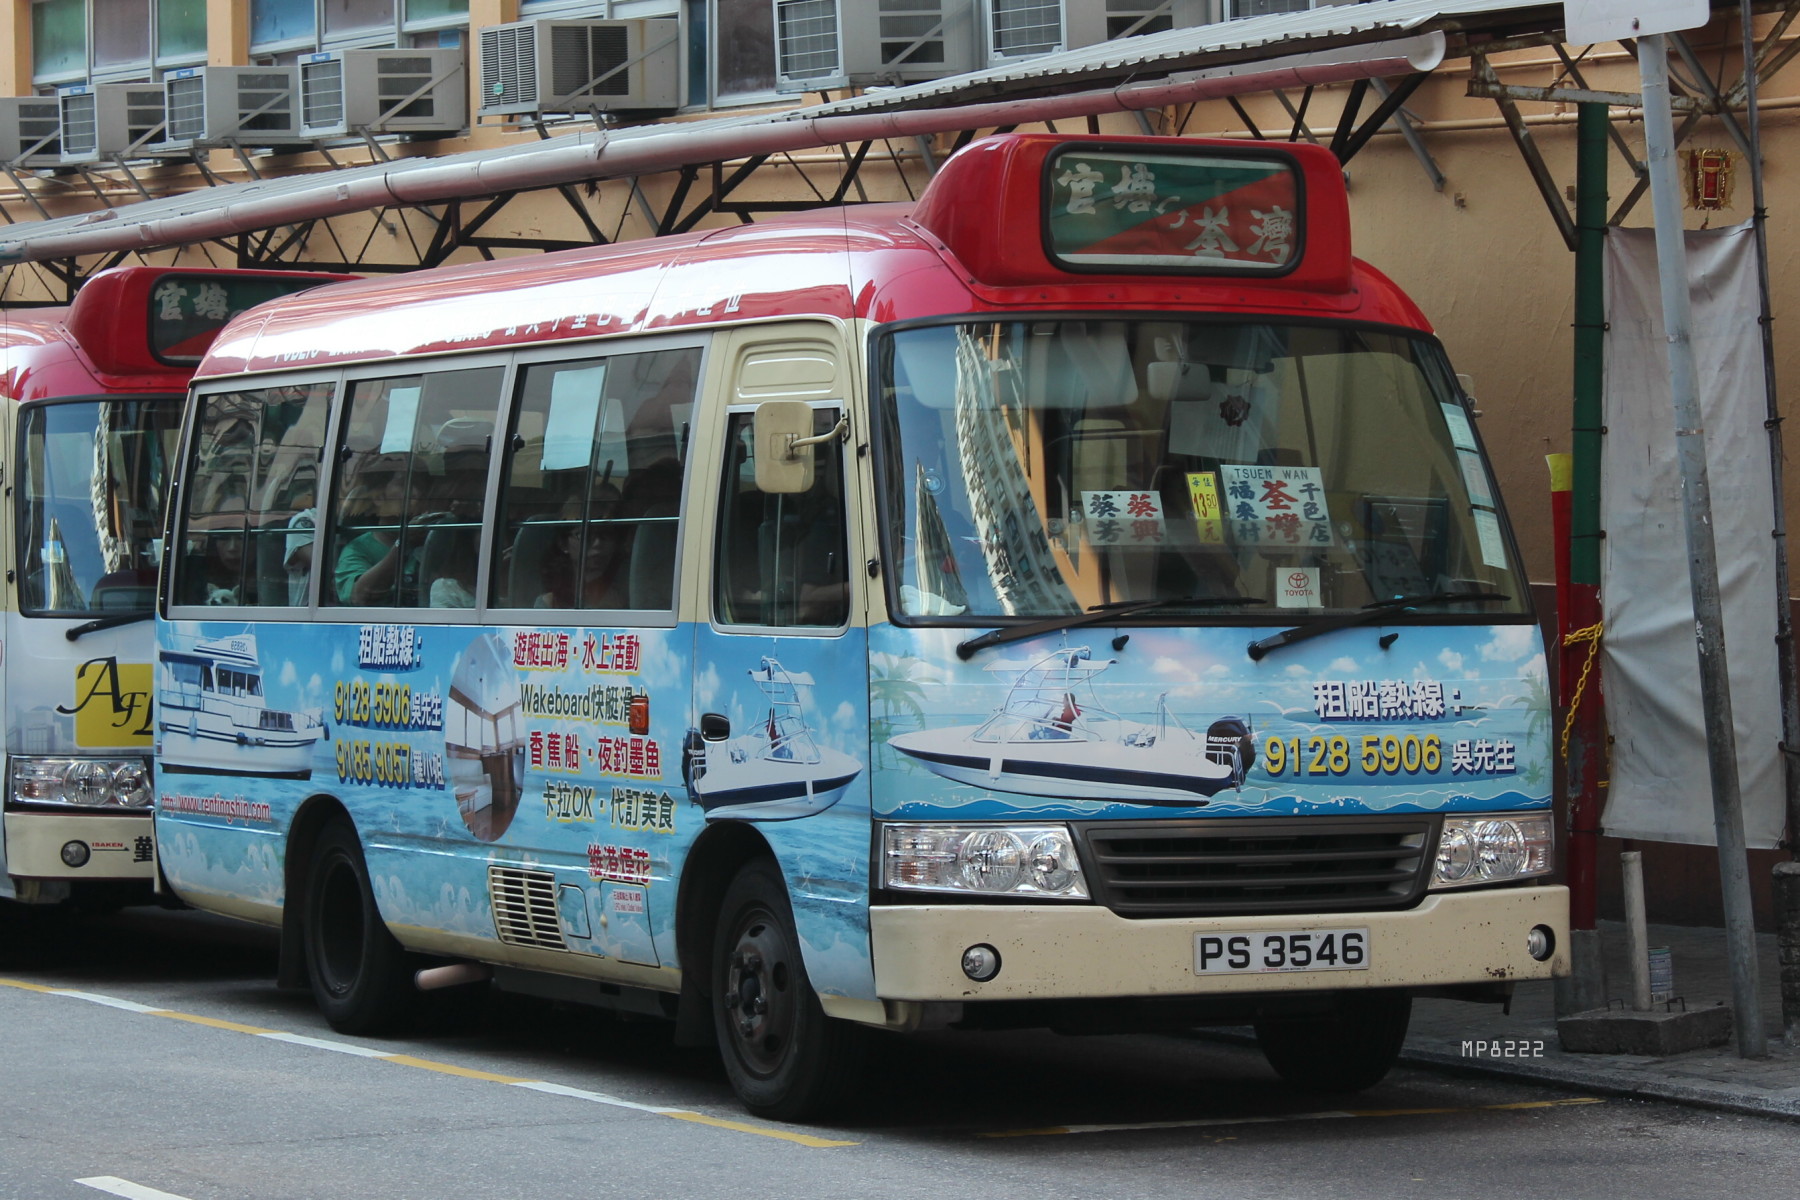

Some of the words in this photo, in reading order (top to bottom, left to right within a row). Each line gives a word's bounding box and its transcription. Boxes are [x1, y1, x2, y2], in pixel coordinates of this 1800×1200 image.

[1057, 162, 1157, 215] 官塘
[1184, 205, 1293, 264] 荃灣
[155, 281, 229, 320] 官塘
[1234, 468, 1273, 480] TSUEN
[1282, 468, 1309, 480] WAN
[1204, 521, 1221, 541] 元
[1259, 480, 1303, 543] 荃灣
[335, 681, 371, 722] 9128
[374, 683, 411, 725] 5906
[411, 692, 442, 727] 吳先生
[336, 739, 372, 780] 9185
[375, 742, 411, 783] 9057
[1265, 735, 1349, 774] 9128
[1361, 734, 1441, 772] 5906
[1452, 739, 1516, 772] 吳先生
[1200, 936, 1251, 970] PS
[1263, 932, 1364, 967] 3546
